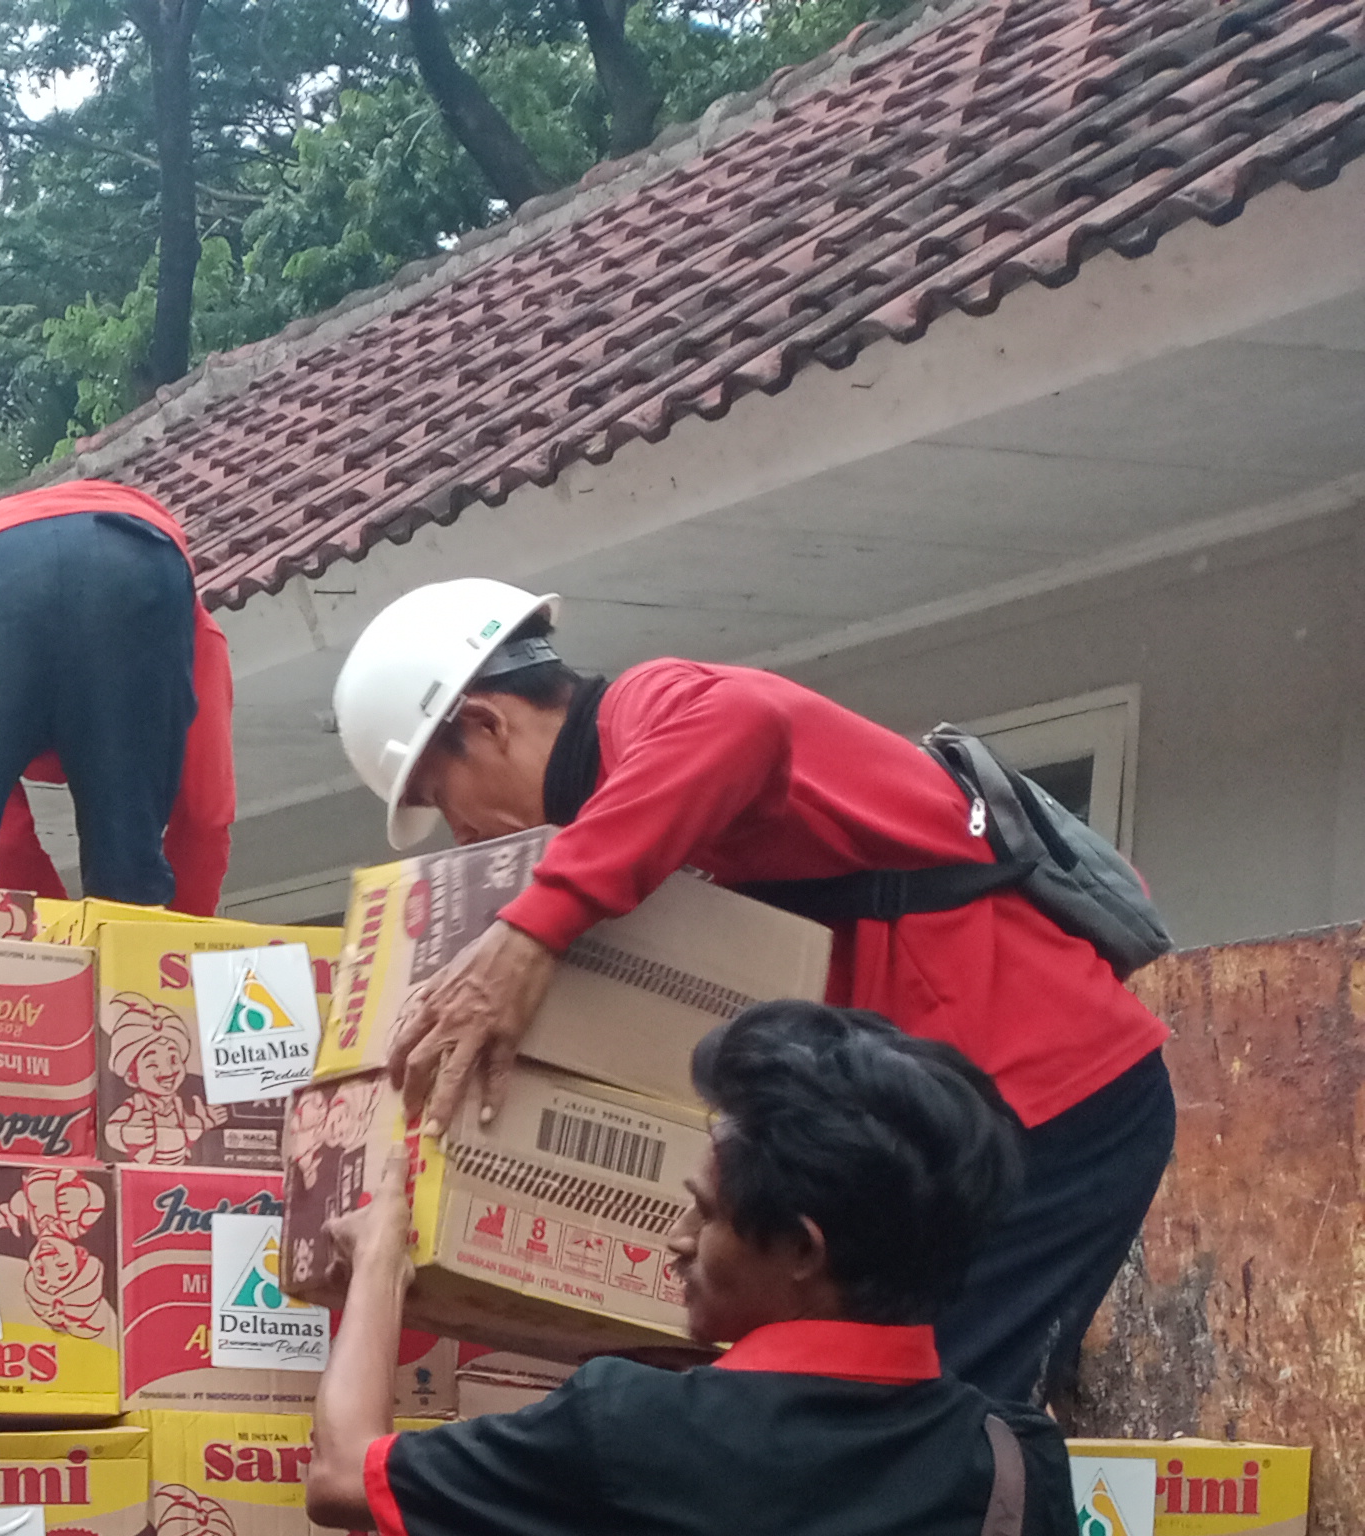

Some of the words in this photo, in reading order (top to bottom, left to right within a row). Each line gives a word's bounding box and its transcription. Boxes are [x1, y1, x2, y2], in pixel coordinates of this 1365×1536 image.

[214, 1039, 310, 1067] DeltaMas
[25, 1056, 51, 1077] Mi
[219, 1314, 324, 1338] Deltamas
[203, 1442, 314, 1484] sar
